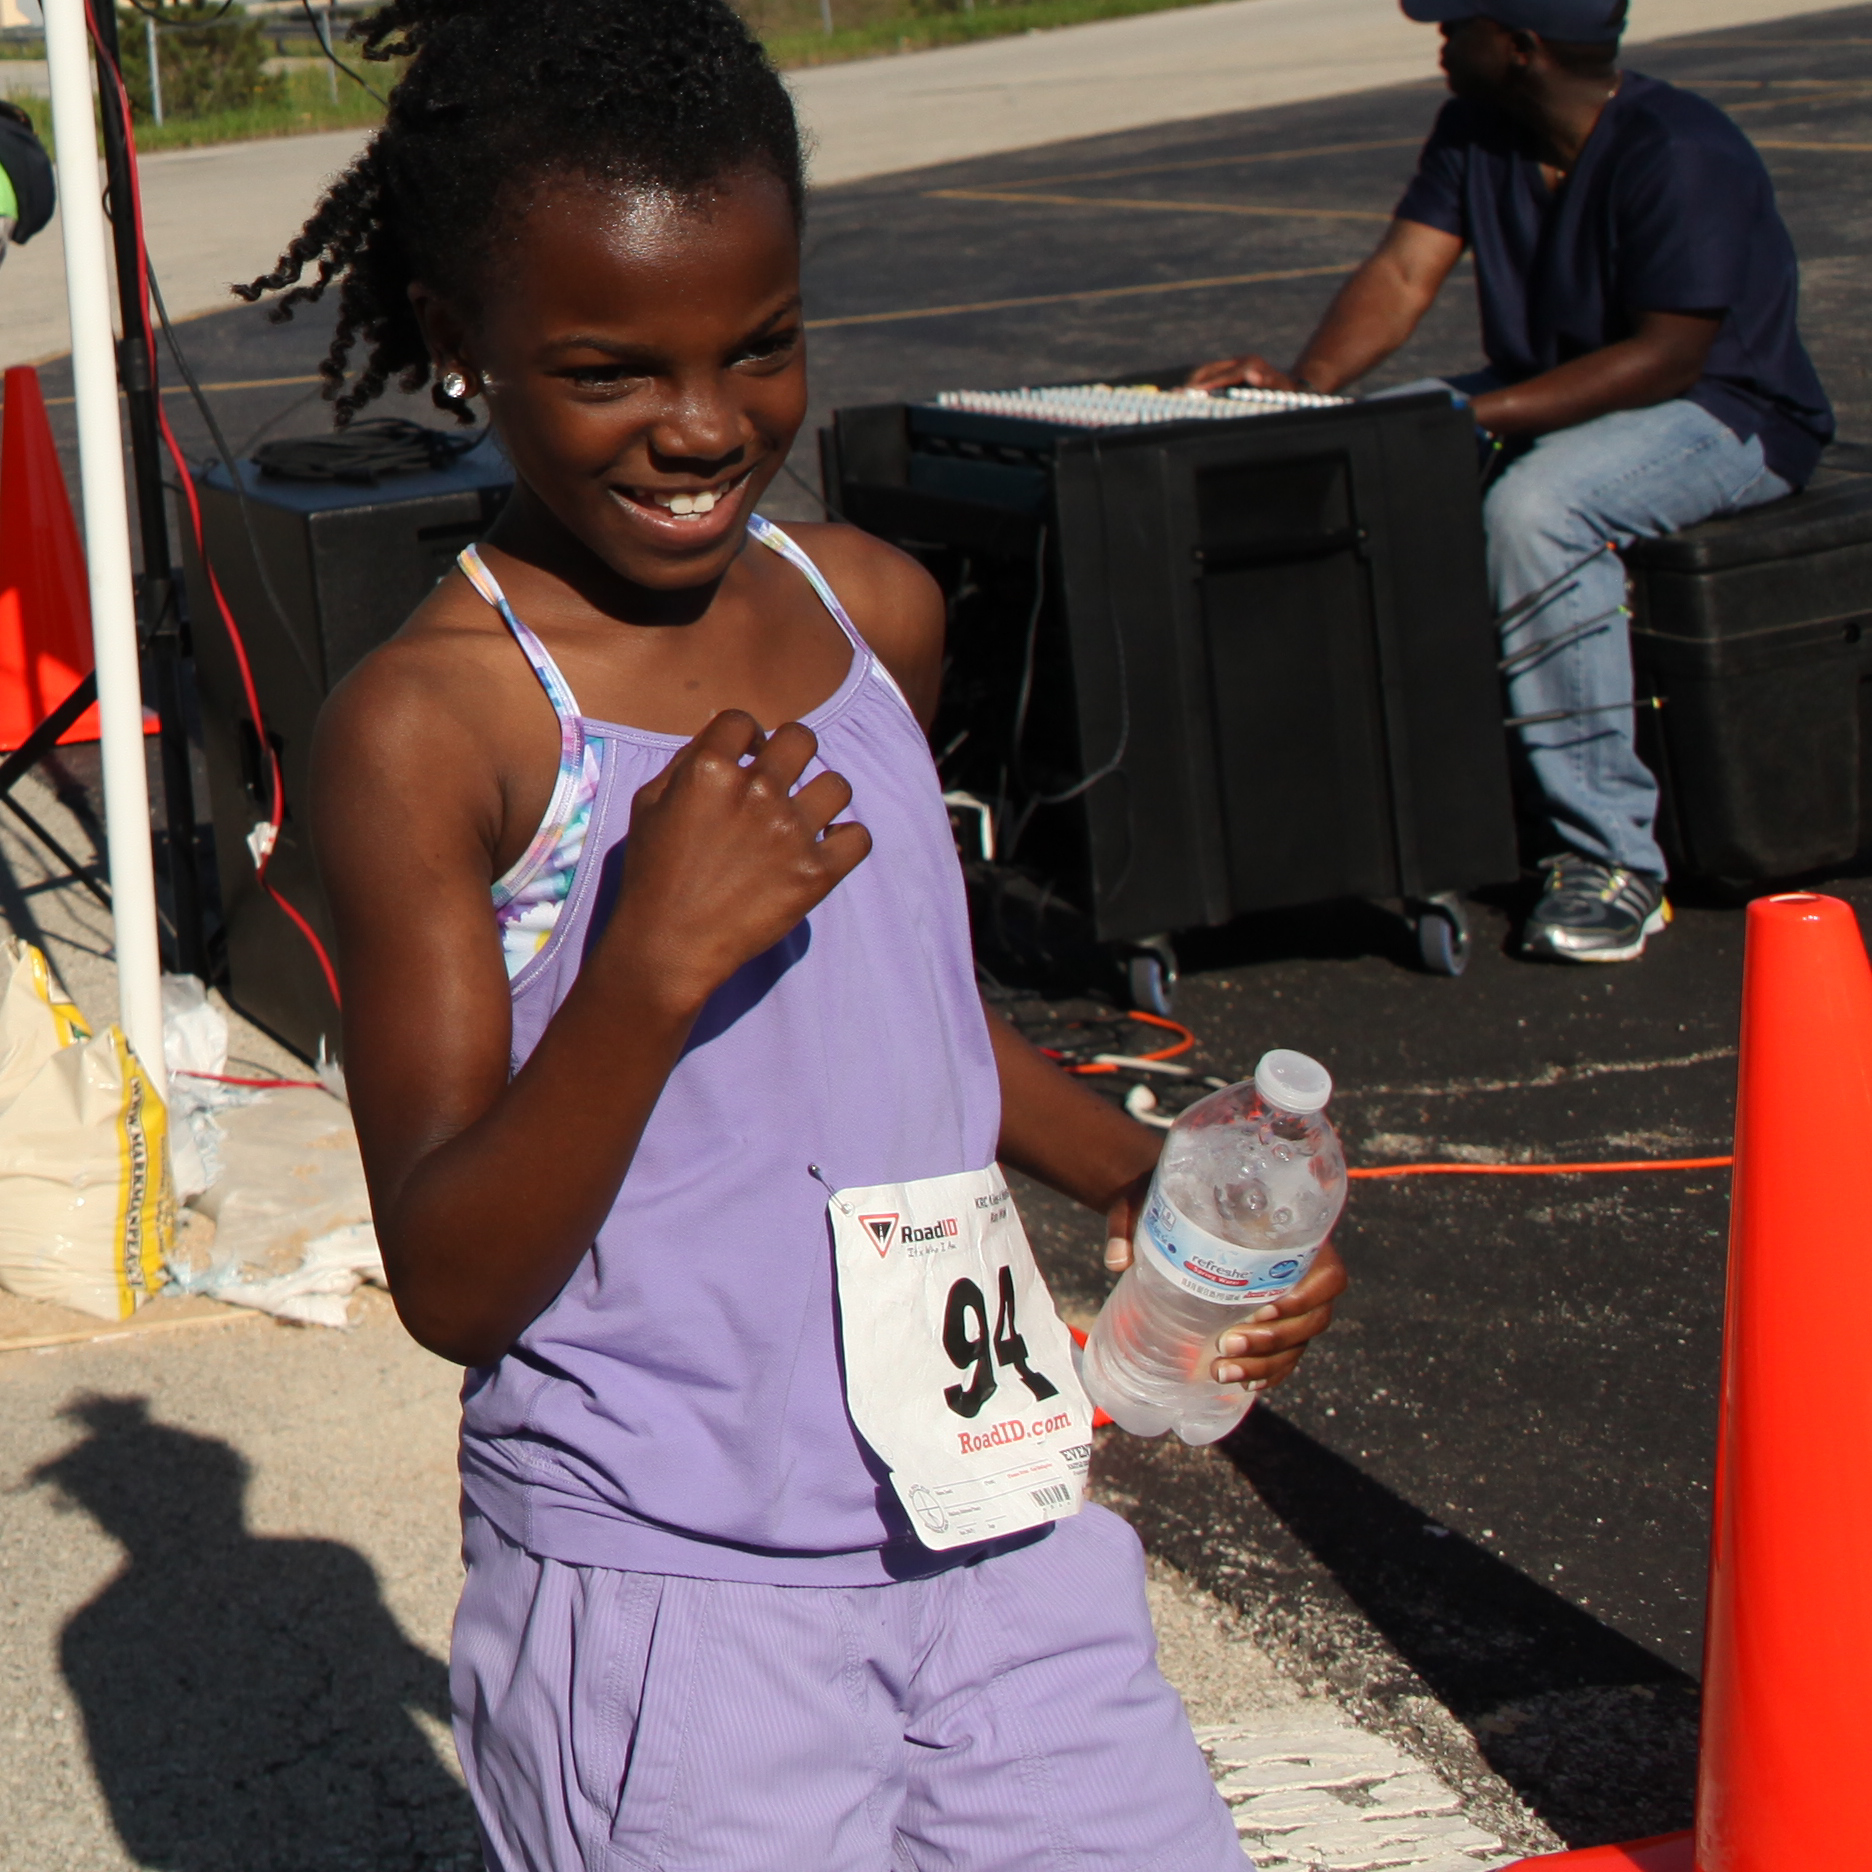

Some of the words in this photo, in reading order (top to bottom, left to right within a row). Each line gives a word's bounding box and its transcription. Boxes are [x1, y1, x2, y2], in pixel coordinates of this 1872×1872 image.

[901, 1217, 958, 1244] RoadID
[942, 1265, 1060, 1418] 94
[957, 1412, 1072, 1456] RoadID.com
